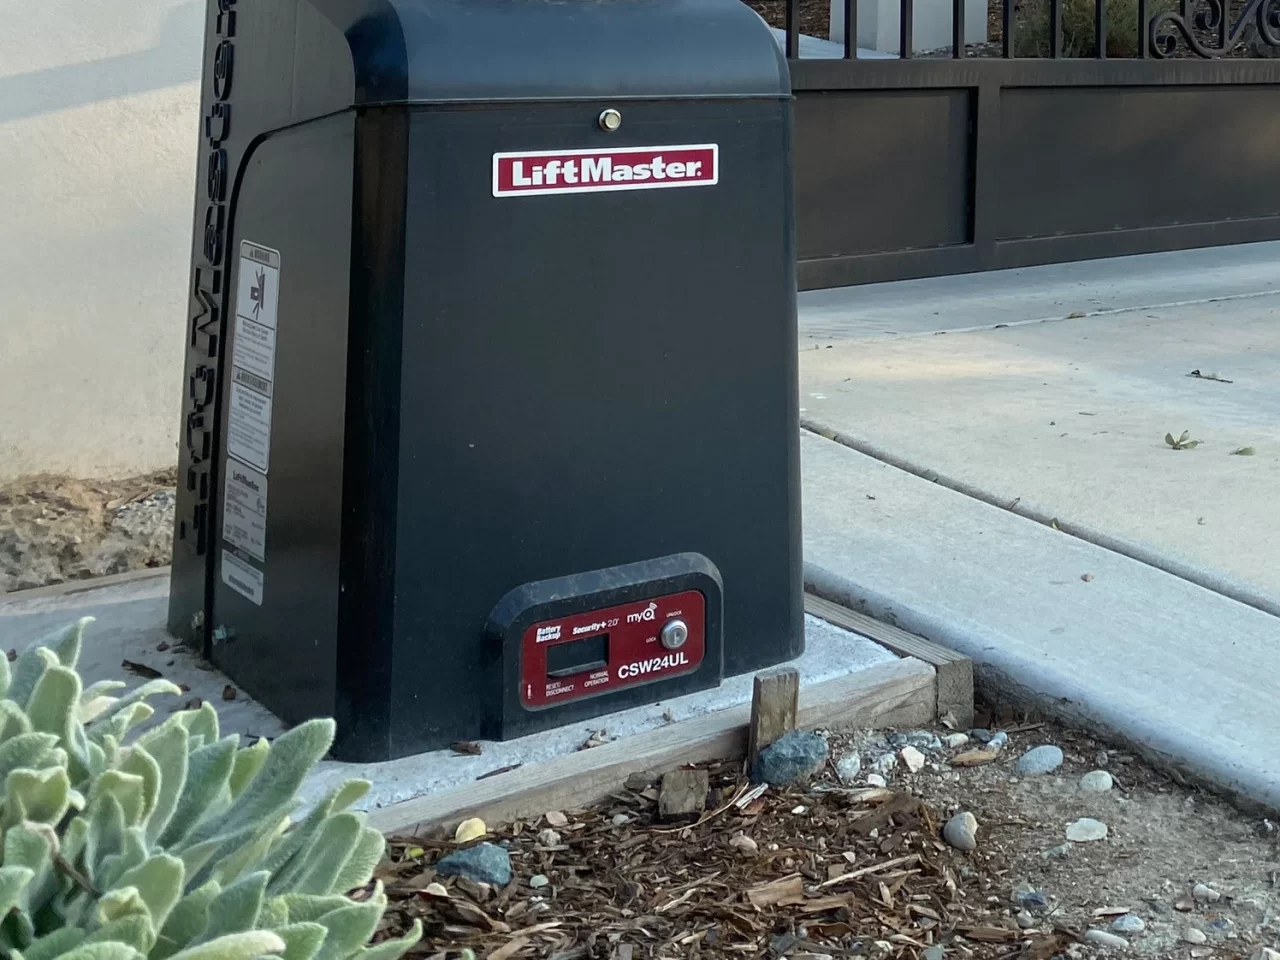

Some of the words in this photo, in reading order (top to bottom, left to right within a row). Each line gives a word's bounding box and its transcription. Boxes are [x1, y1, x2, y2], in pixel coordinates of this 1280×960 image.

[512, 155, 702, 187] LiftMaster
[627, 606, 656, 623] myQ
[536, 625, 562, 636] Battery
[536, 632, 562, 643] Backup
[617, 651, 689, 679] CSW24UL
[589, 670, 609, 680] NORMAL
[583, 676, 609, 688] OPERATION
[546, 684, 575, 697] DISCONNECT
